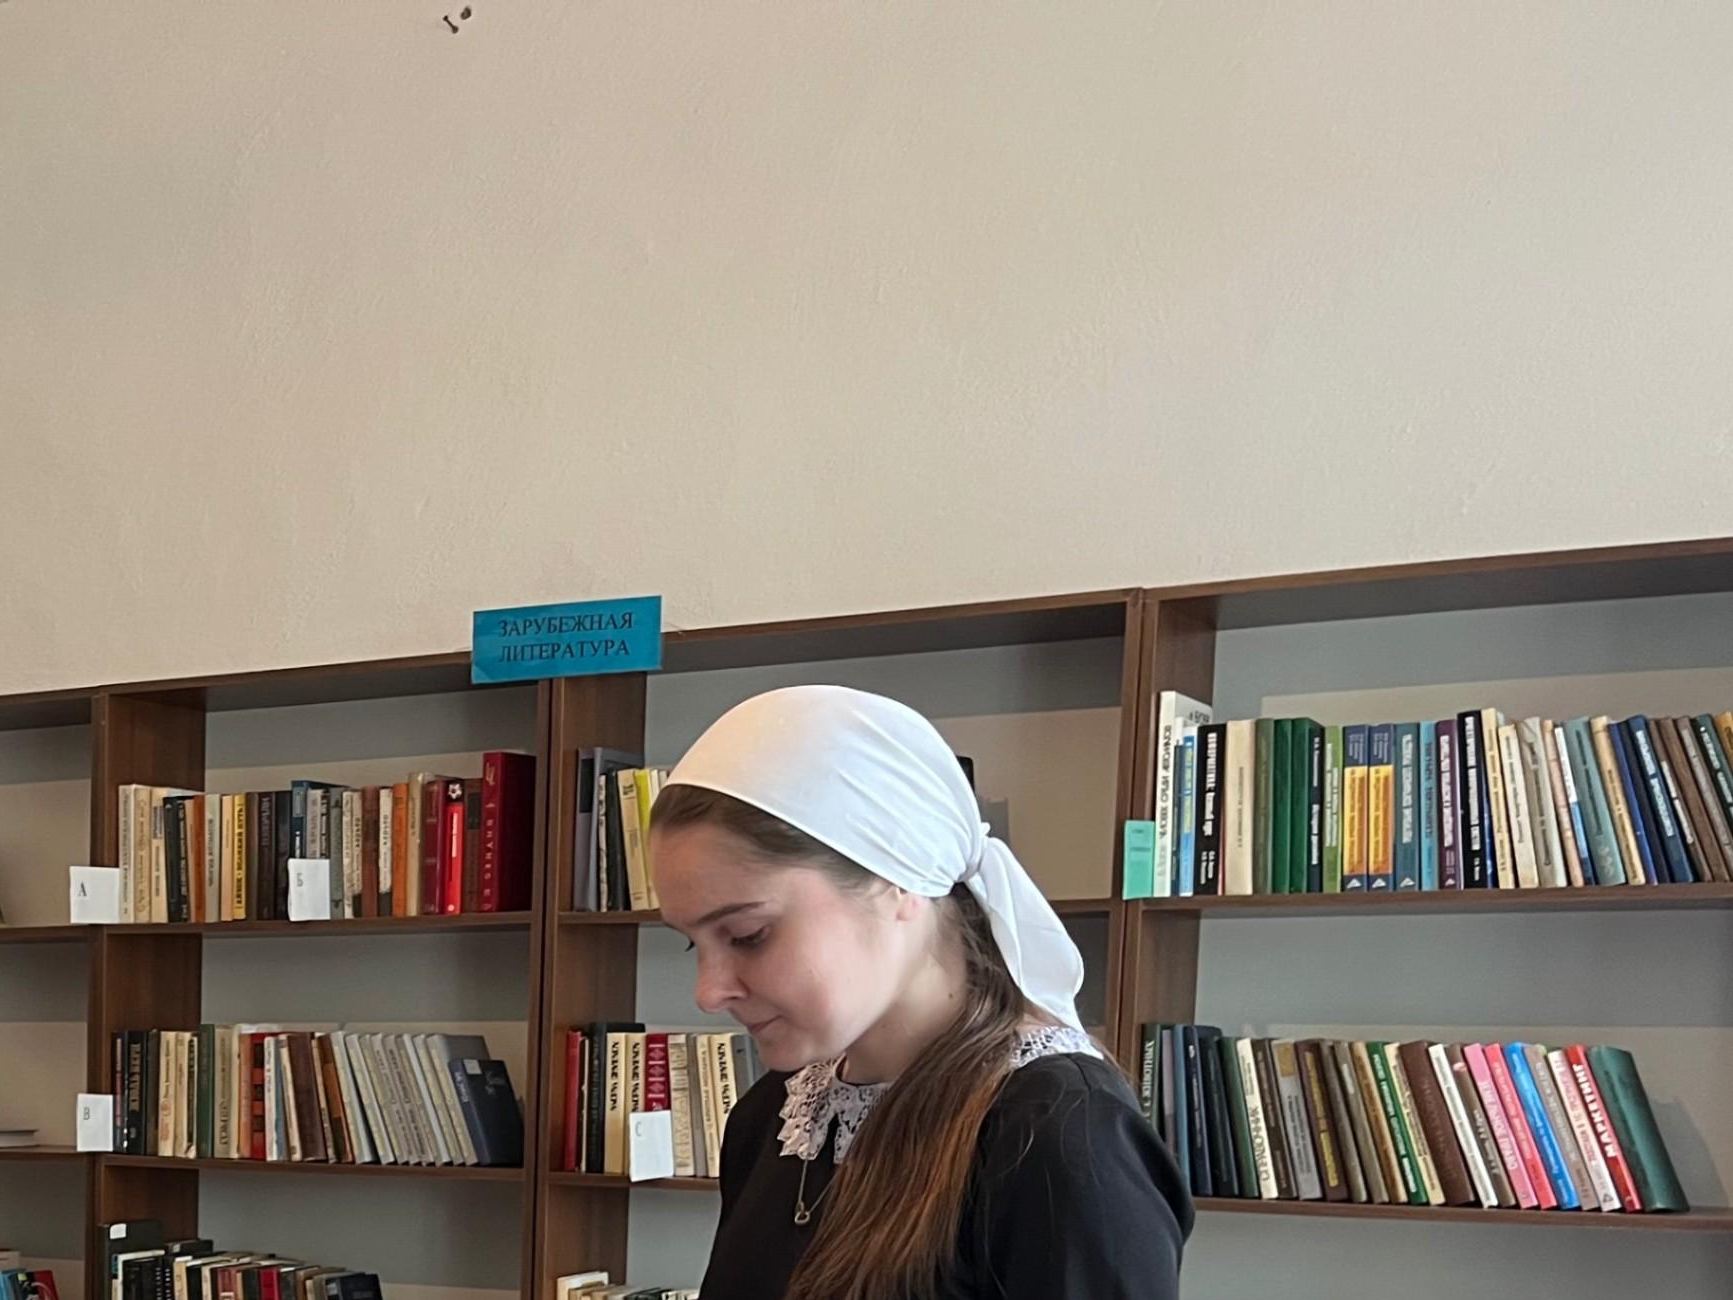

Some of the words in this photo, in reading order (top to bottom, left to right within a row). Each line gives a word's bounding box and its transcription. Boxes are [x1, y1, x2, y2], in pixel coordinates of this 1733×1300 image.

[498, 612, 633, 637] ЗАРУБЕЖНАЯ
[499, 639, 630, 662] ЛИТЕРАТУРА
[1159, 806, 1168, 839] ЧЕЛОВЕК
[78, 881, 87, 897] А
[296, 872, 304, 887] Б
[83, 1106, 91, 1120] В
[1573, 1063, 1618, 1158] МАРКЕТИНГ
[1248, 1105, 1270, 1182] СПРАВОЧНИК
